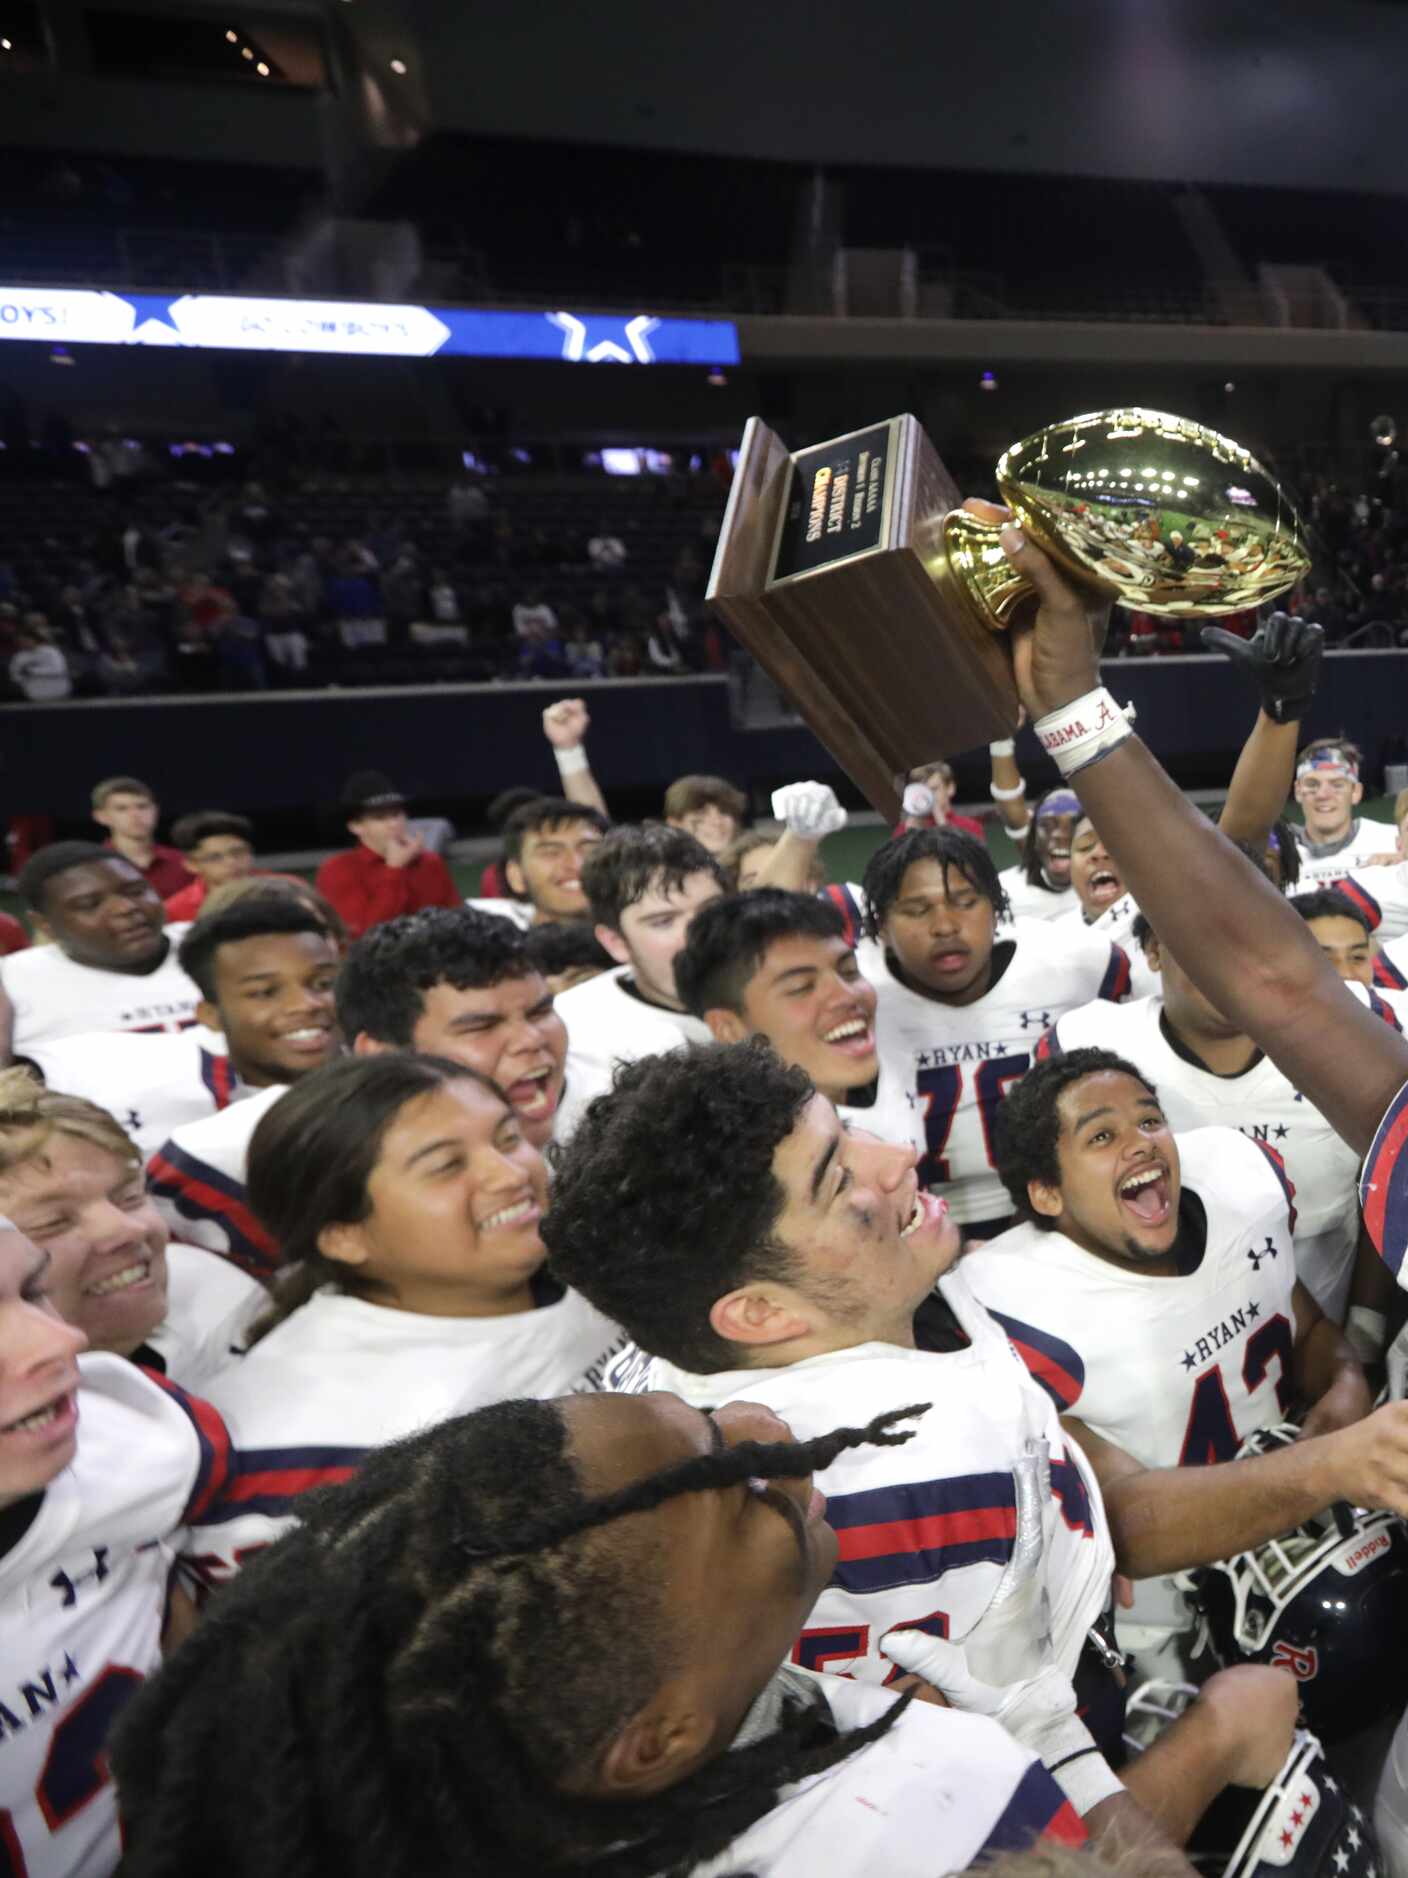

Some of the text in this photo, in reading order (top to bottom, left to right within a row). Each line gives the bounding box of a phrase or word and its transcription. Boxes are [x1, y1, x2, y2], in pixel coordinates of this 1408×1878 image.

[805, 466, 833, 543] CHAMPIONS
[932, 1042, 991, 1066] RYAN
[1194, 1307, 1248, 1363] RYAN
[1345, 1534, 1389, 1569] Riddell
